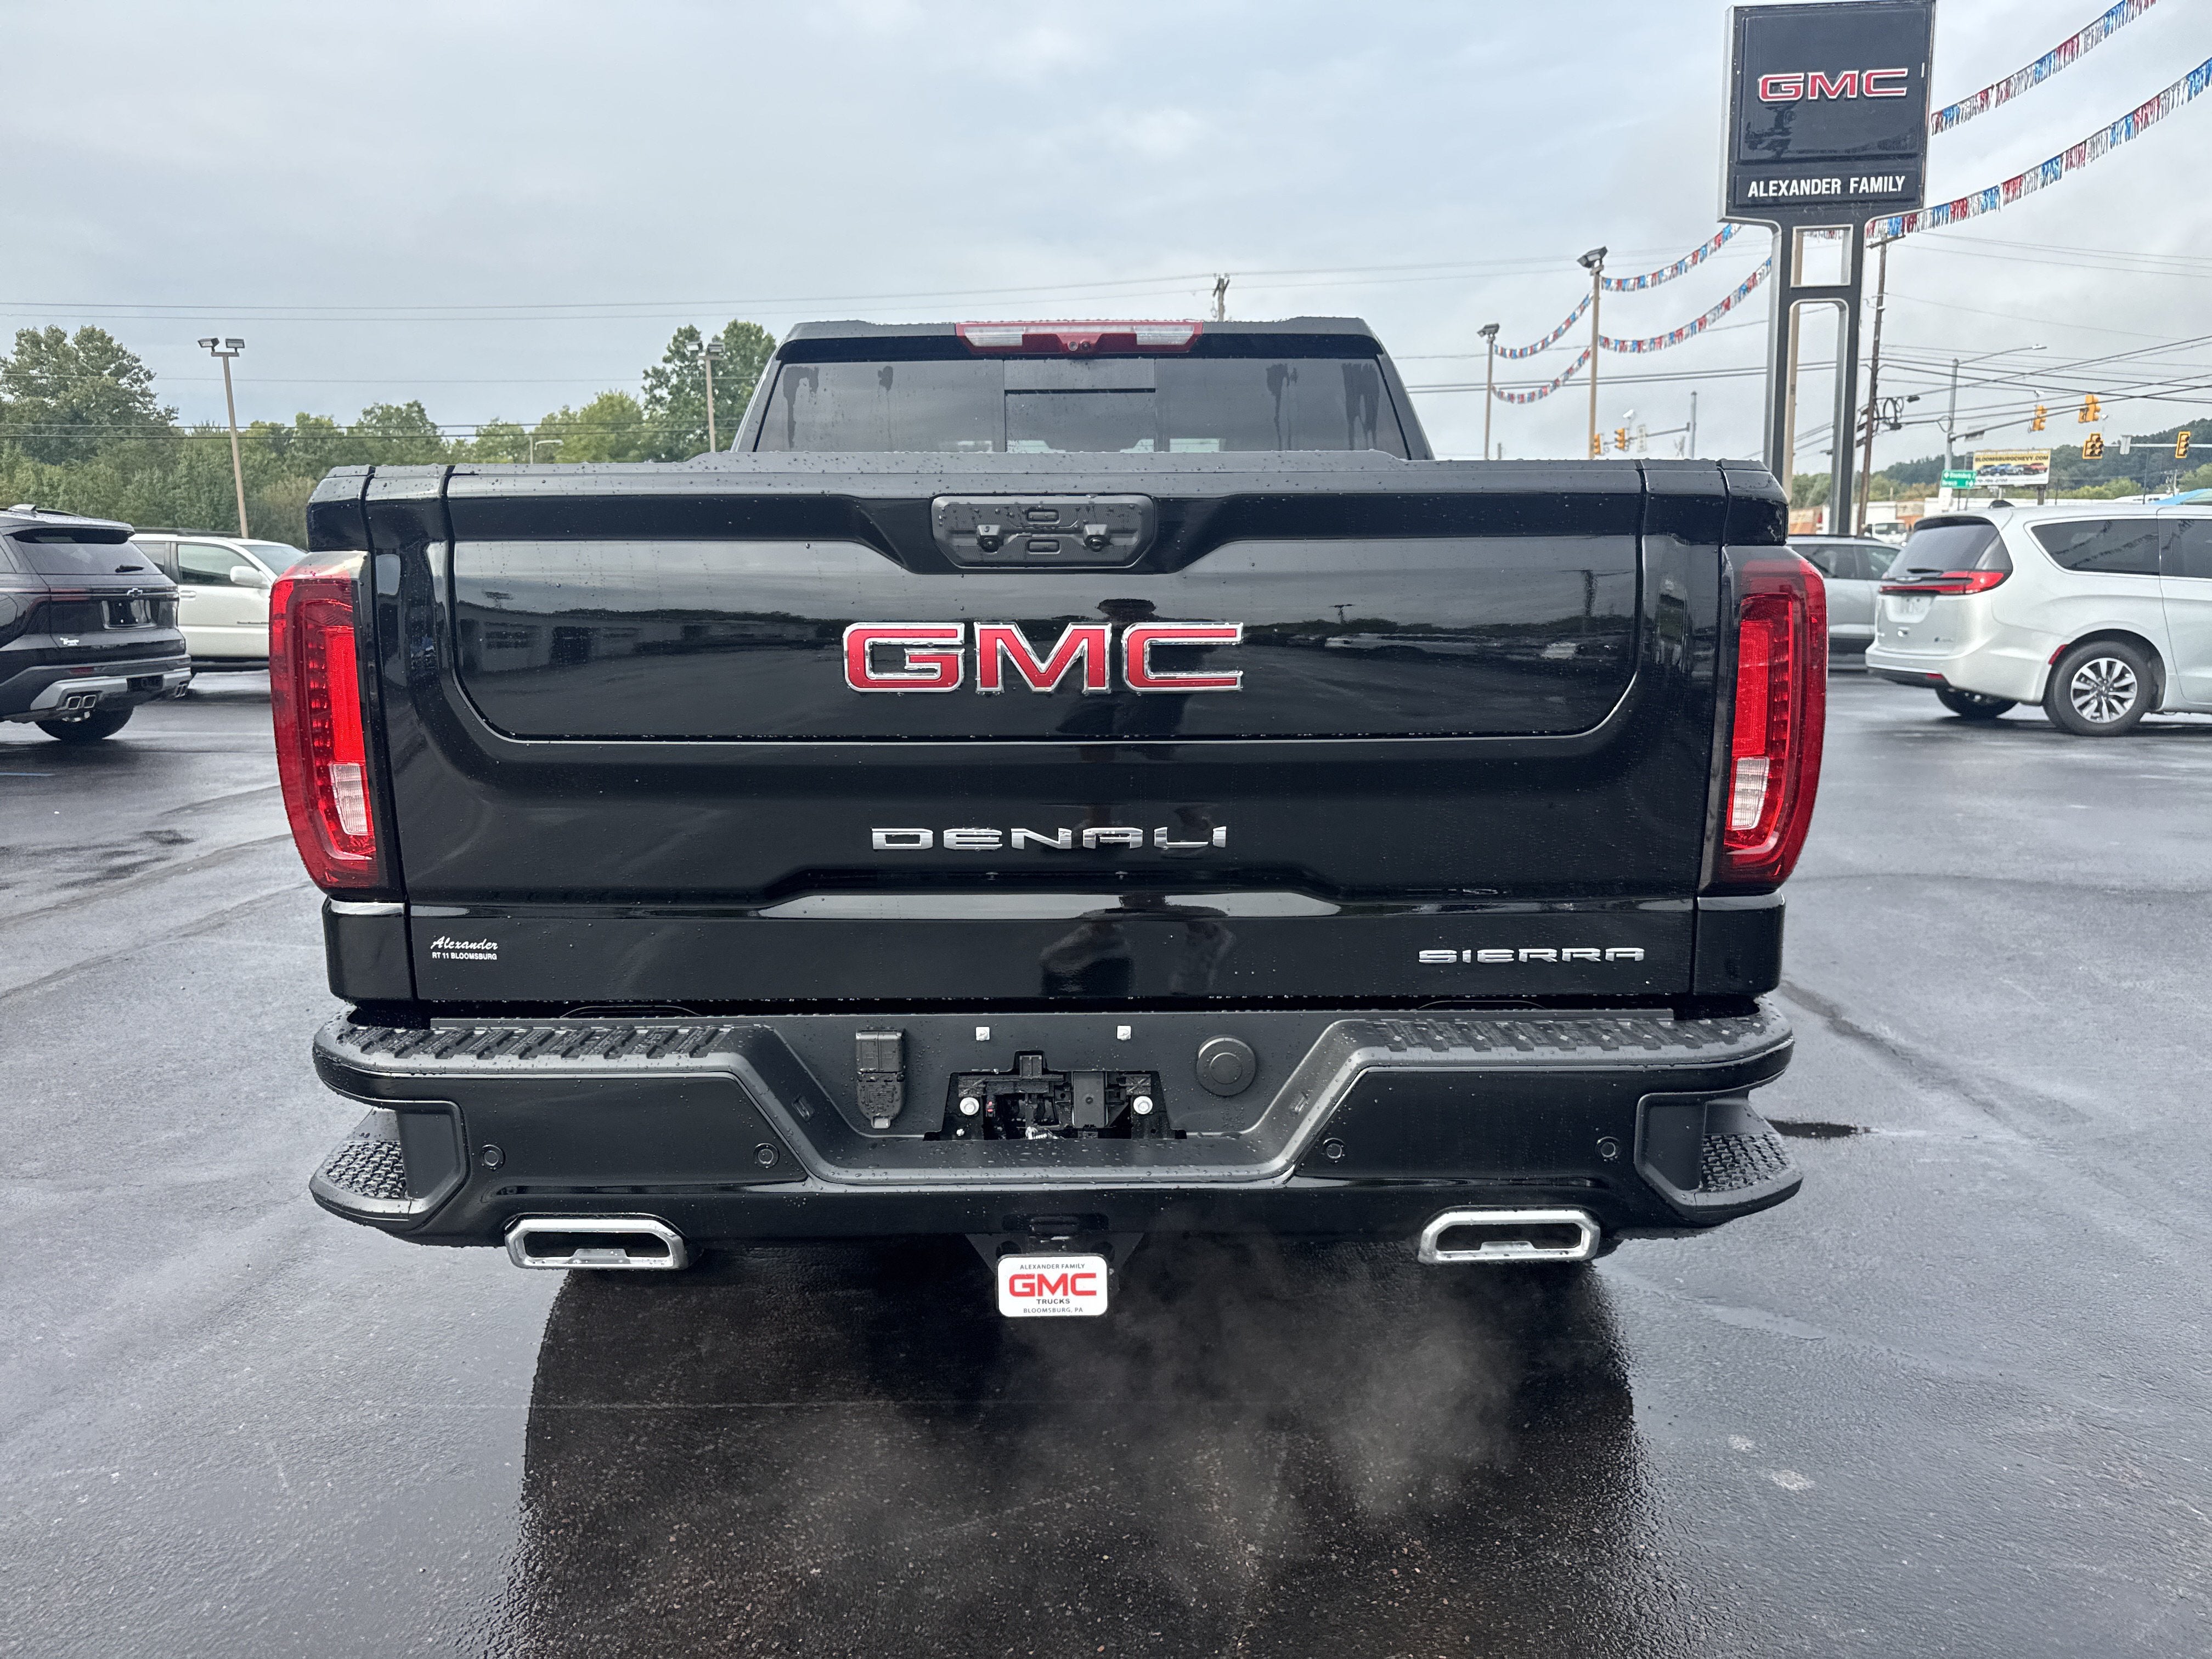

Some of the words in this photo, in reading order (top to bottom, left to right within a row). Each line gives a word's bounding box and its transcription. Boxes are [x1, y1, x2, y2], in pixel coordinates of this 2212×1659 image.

[1758, 68, 1909, 102] GMC
[1747, 178, 1841, 198] ALEXANDER
[1849, 176, 1905, 194] FAMILY
[843, 622, 1244, 694] GMC
[871, 826, 1227, 850] DENALI
[430, 935, 499, 950] Alexander
[450, 952, 498, 960] BLOOMSBURG
[1418, 947, 1645, 964] SIERRA
[1009, 1273, 1097, 1297] GMC
